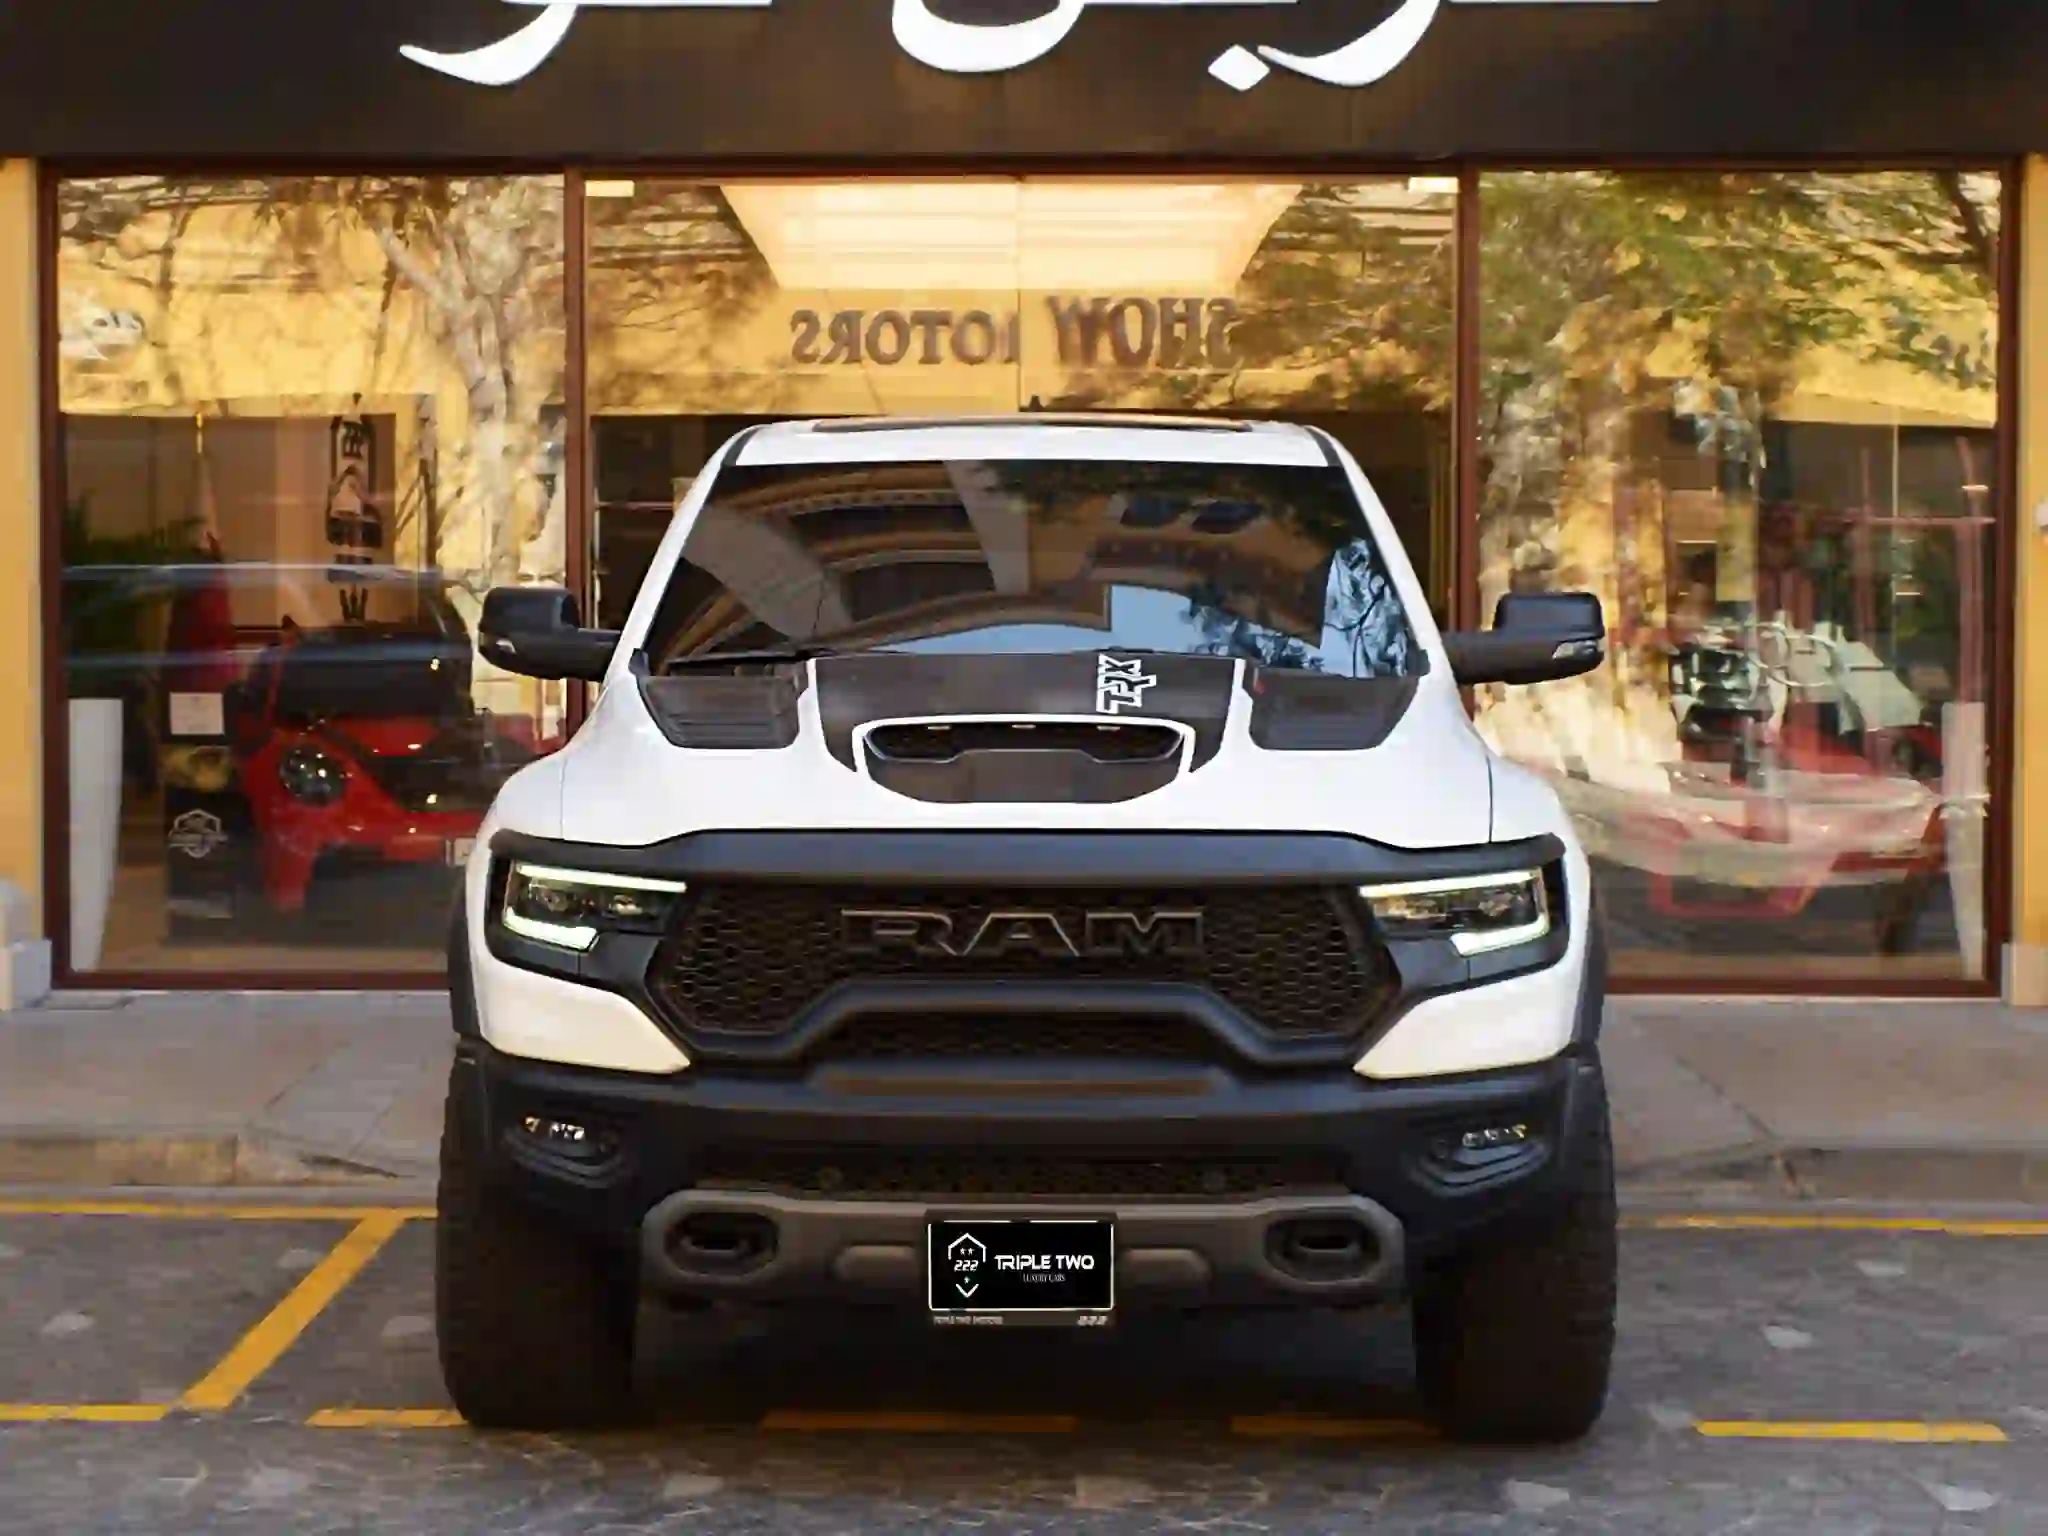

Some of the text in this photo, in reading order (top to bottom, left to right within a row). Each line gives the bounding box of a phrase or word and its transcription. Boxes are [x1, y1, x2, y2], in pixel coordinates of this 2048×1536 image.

[1096, 653, 1157, 714] TRX
[841, 909, 1203, 957] RAM
[953, 1259, 979, 1272] 222
[994, 1254, 1095, 1270] TRIPLE TWO
